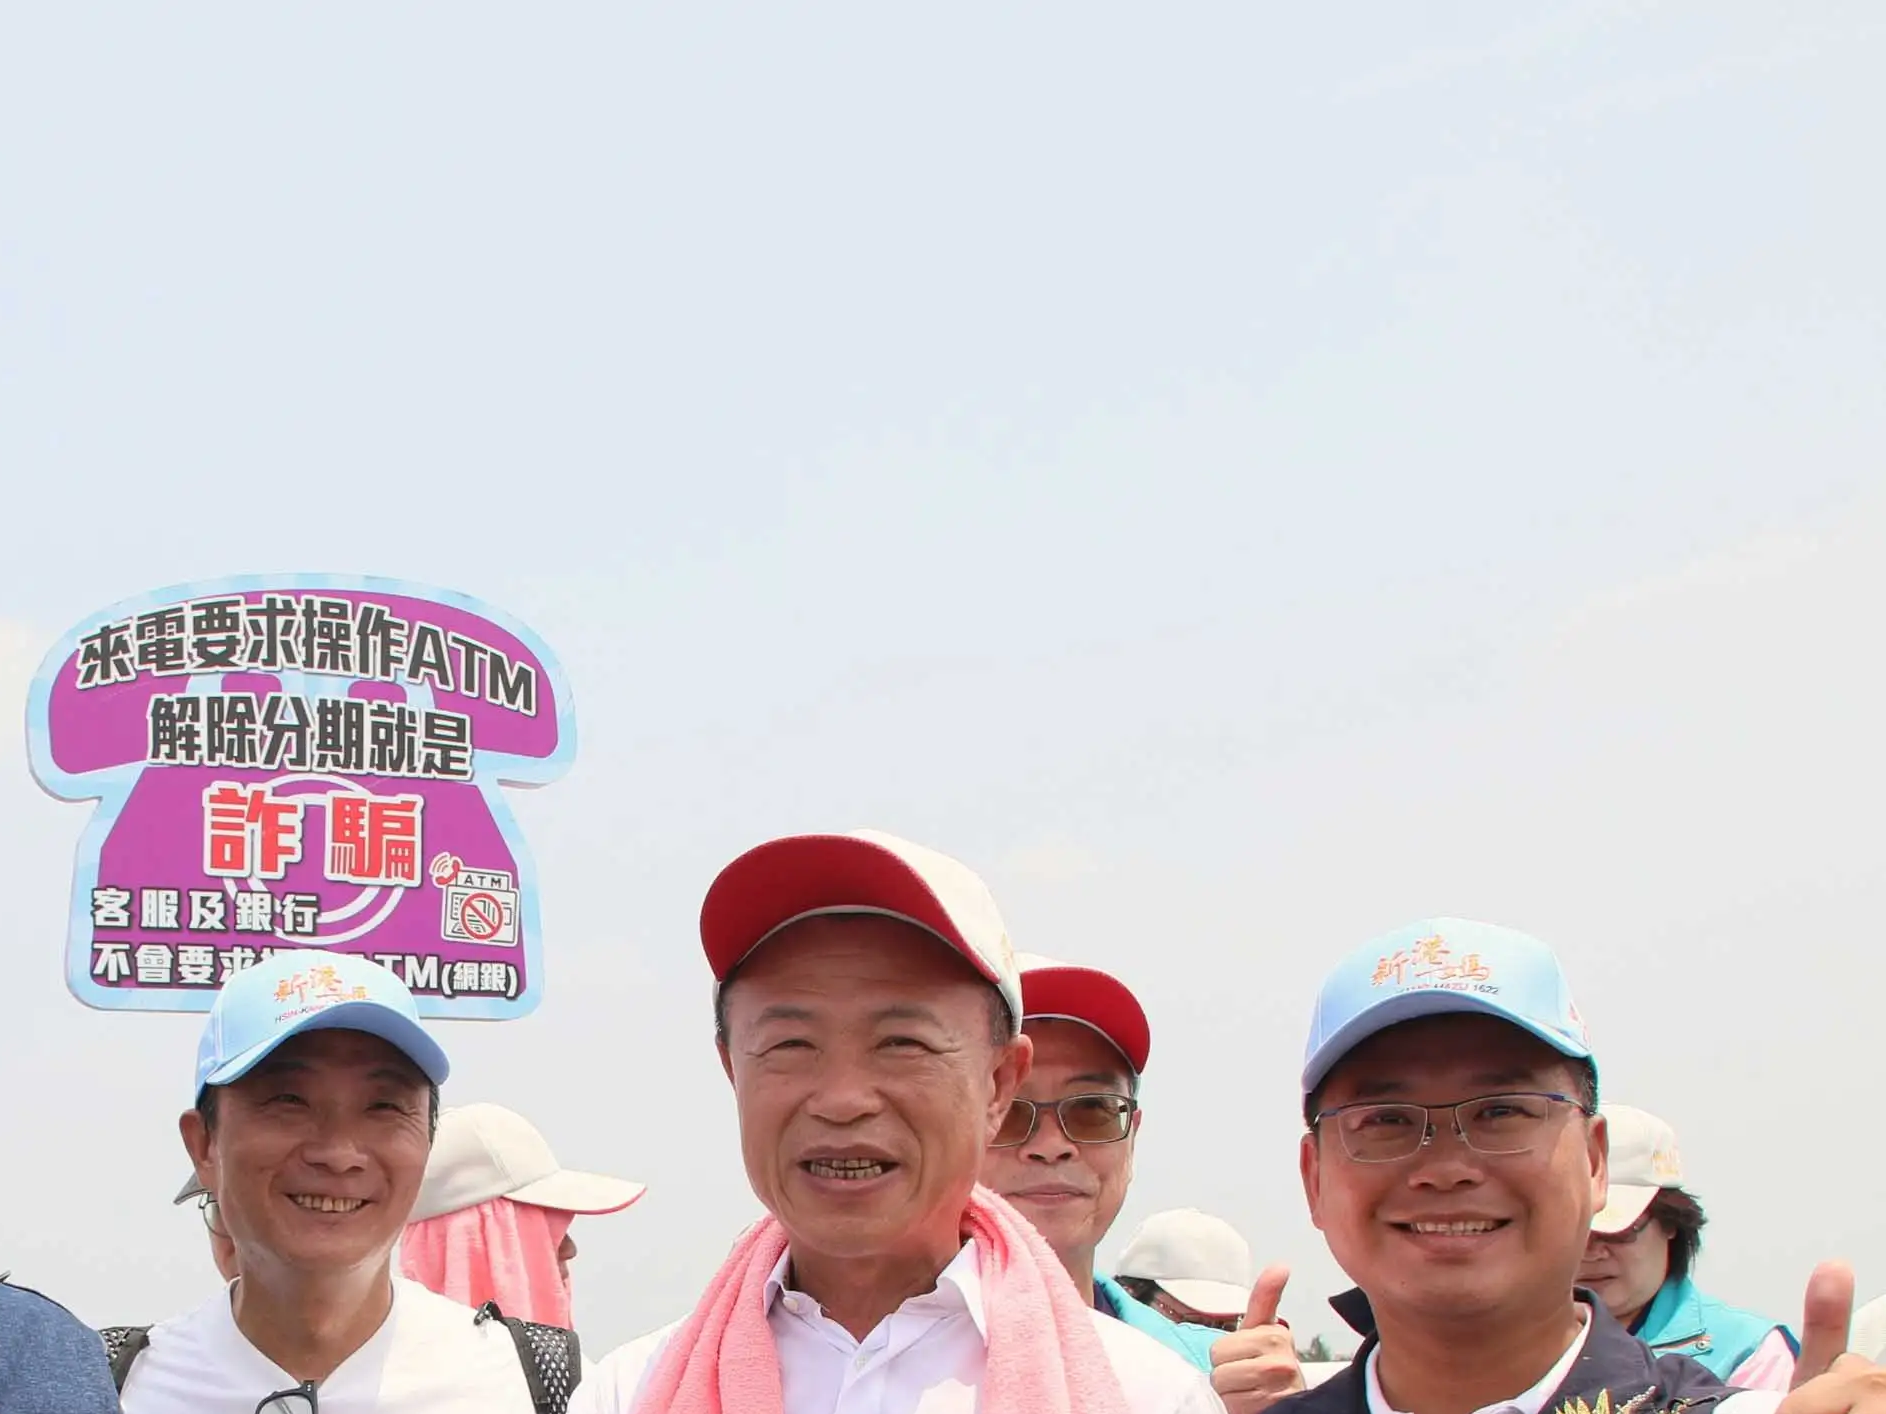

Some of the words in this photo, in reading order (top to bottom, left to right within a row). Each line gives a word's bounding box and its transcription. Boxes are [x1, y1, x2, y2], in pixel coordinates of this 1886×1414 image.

[78, 597, 538, 714] 來電要求操作ATM
[149, 696, 472, 779] 解除分期就是
[207, 785, 424, 884] 詐騙
[91, 888, 320, 934] 客服及銀行
[464, 873, 502, 888] ATM
